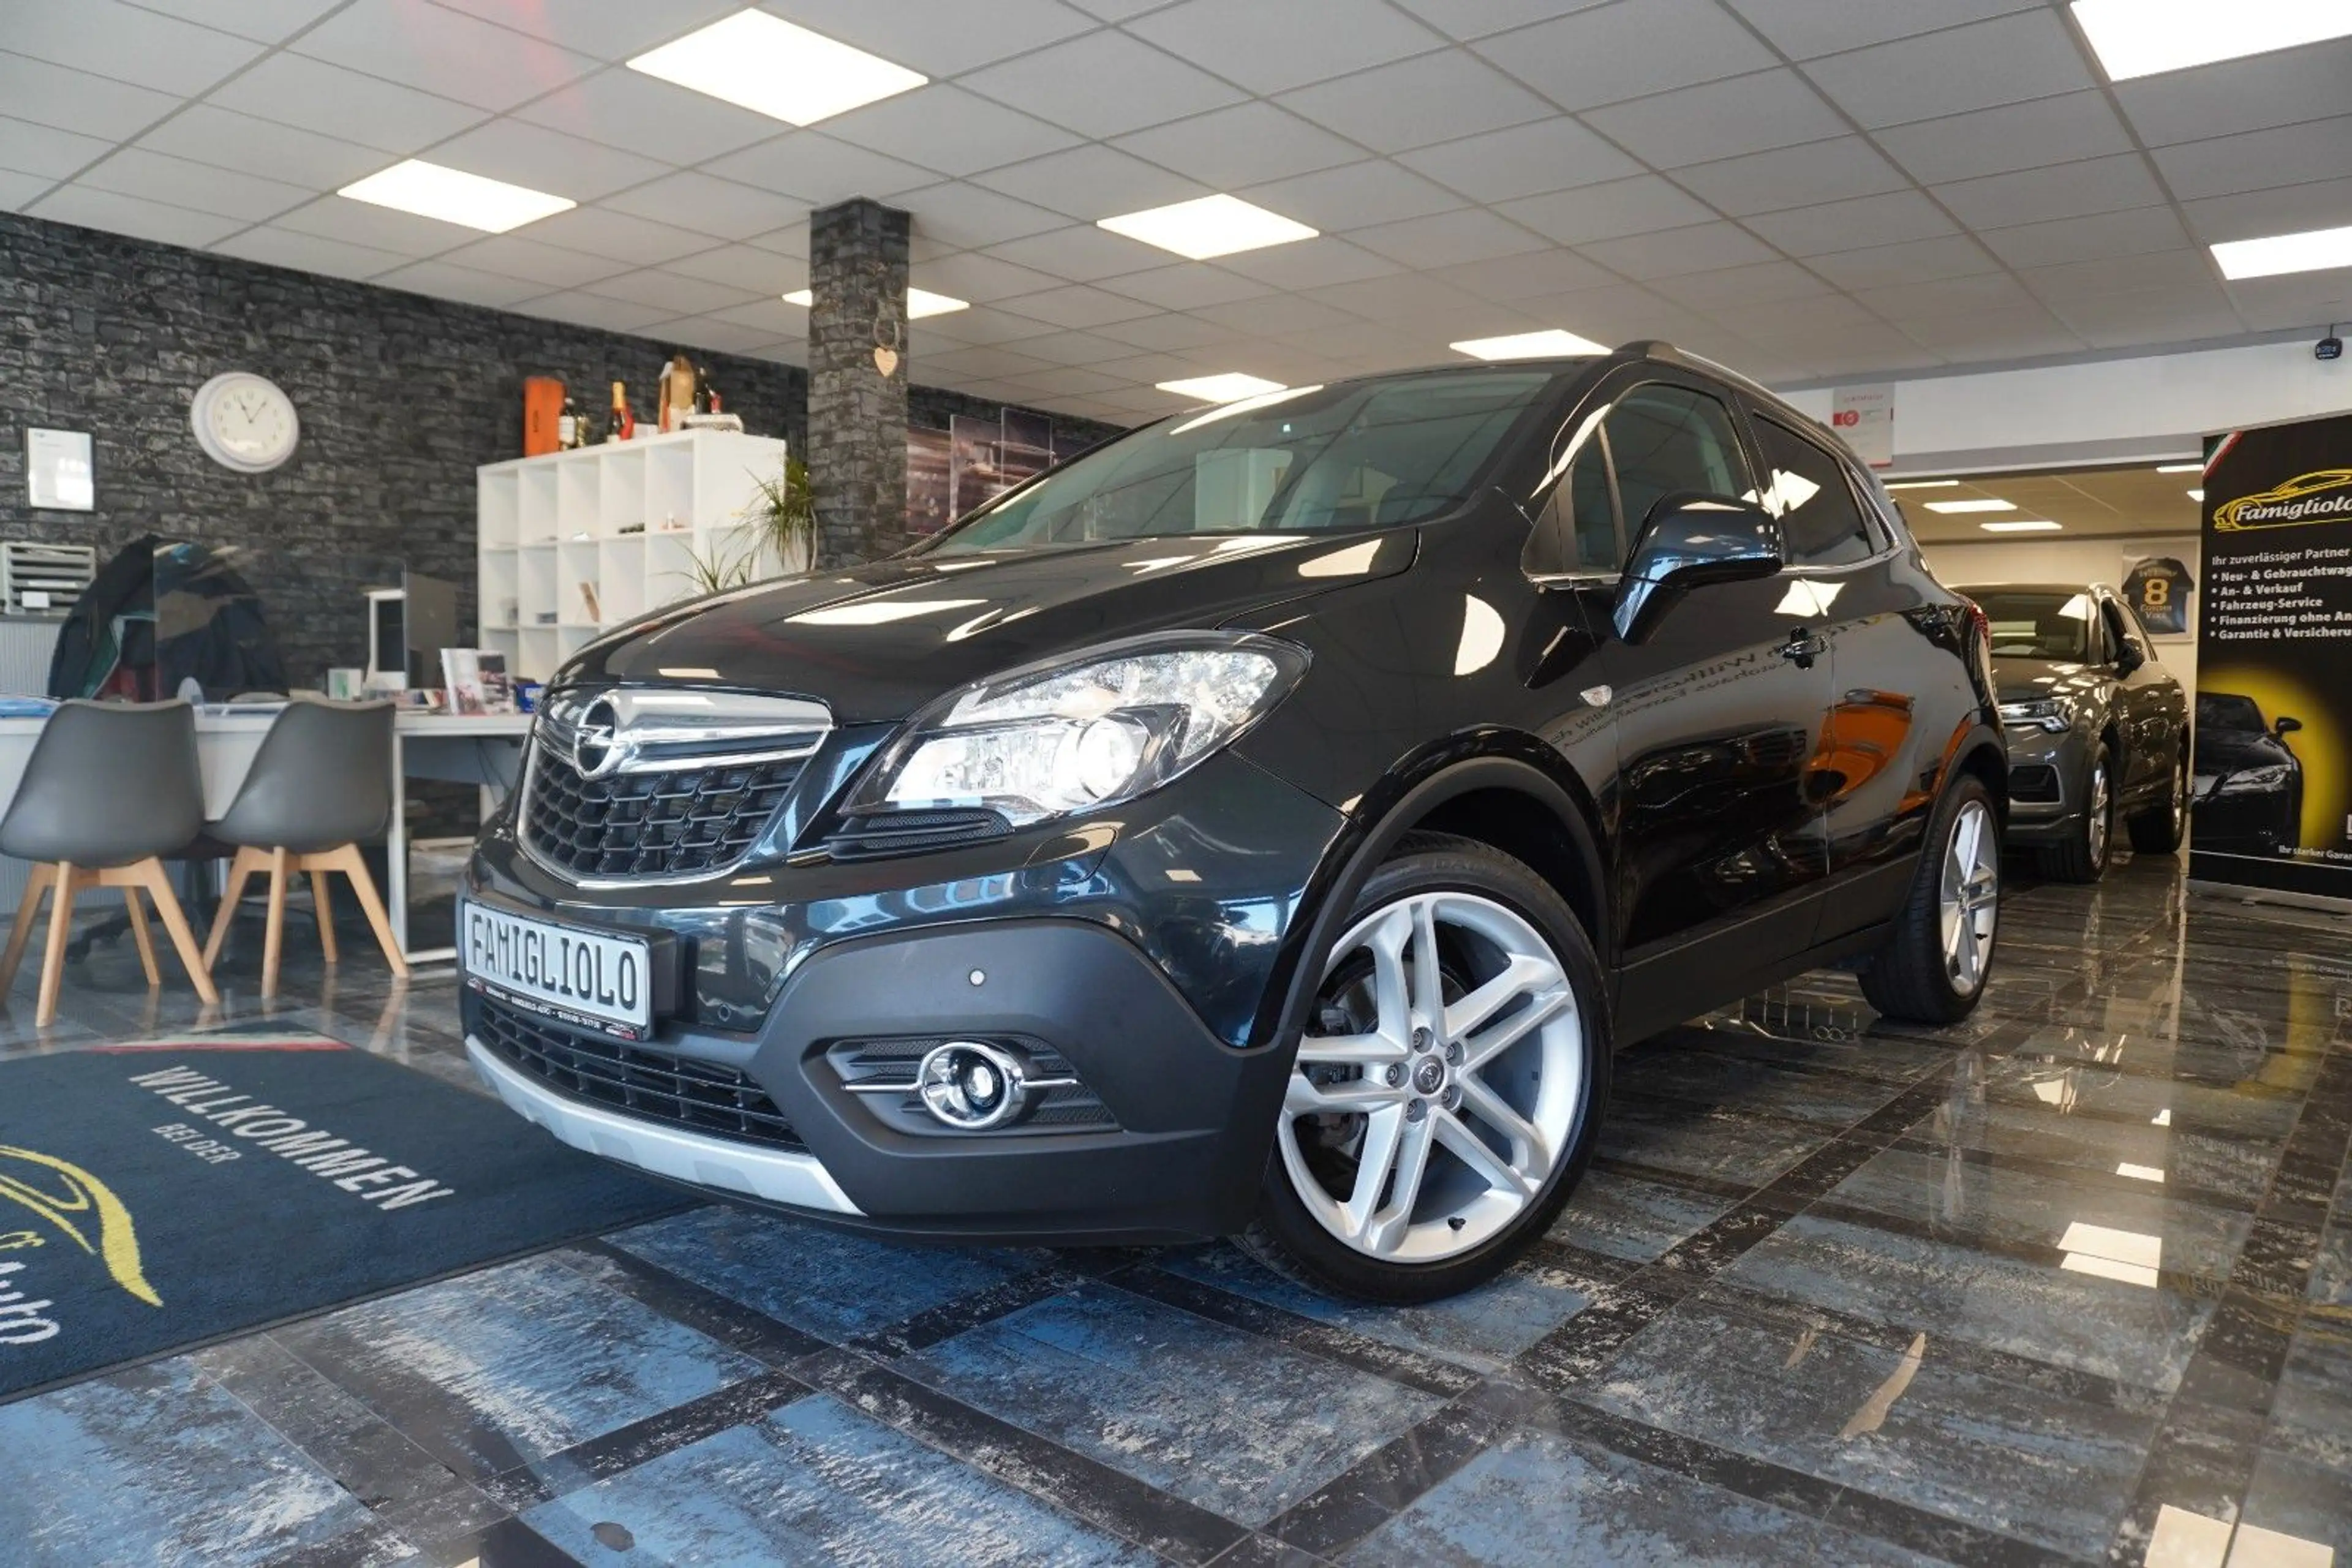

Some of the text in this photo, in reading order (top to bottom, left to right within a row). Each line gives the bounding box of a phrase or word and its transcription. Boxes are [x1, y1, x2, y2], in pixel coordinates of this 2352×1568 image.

[2212, 548, 2351, 566] Ihr zuverlässiger Partner
[2221, 572, 2248, 581] Neu-
[2251, 570, 2260, 580] &
[2144, 578, 2169, 605] 8
[2220, 582, 2303, 596] An- & Verkauf
[2220, 597, 2323, 611] Fahrzeug-Service
[2220, 614, 2297, 625] Finanzierung
[2299, 611, 2332, 623] ohne
[2219, 628, 2270, 639] Garantie
[2272, 628, 2282, 639] &
[472, 913, 637, 1011] FAMIGLIOLO
[128, 1065, 455, 1210] WILLKOMMEN
[151, 1123, 242, 1164] BEI DER
